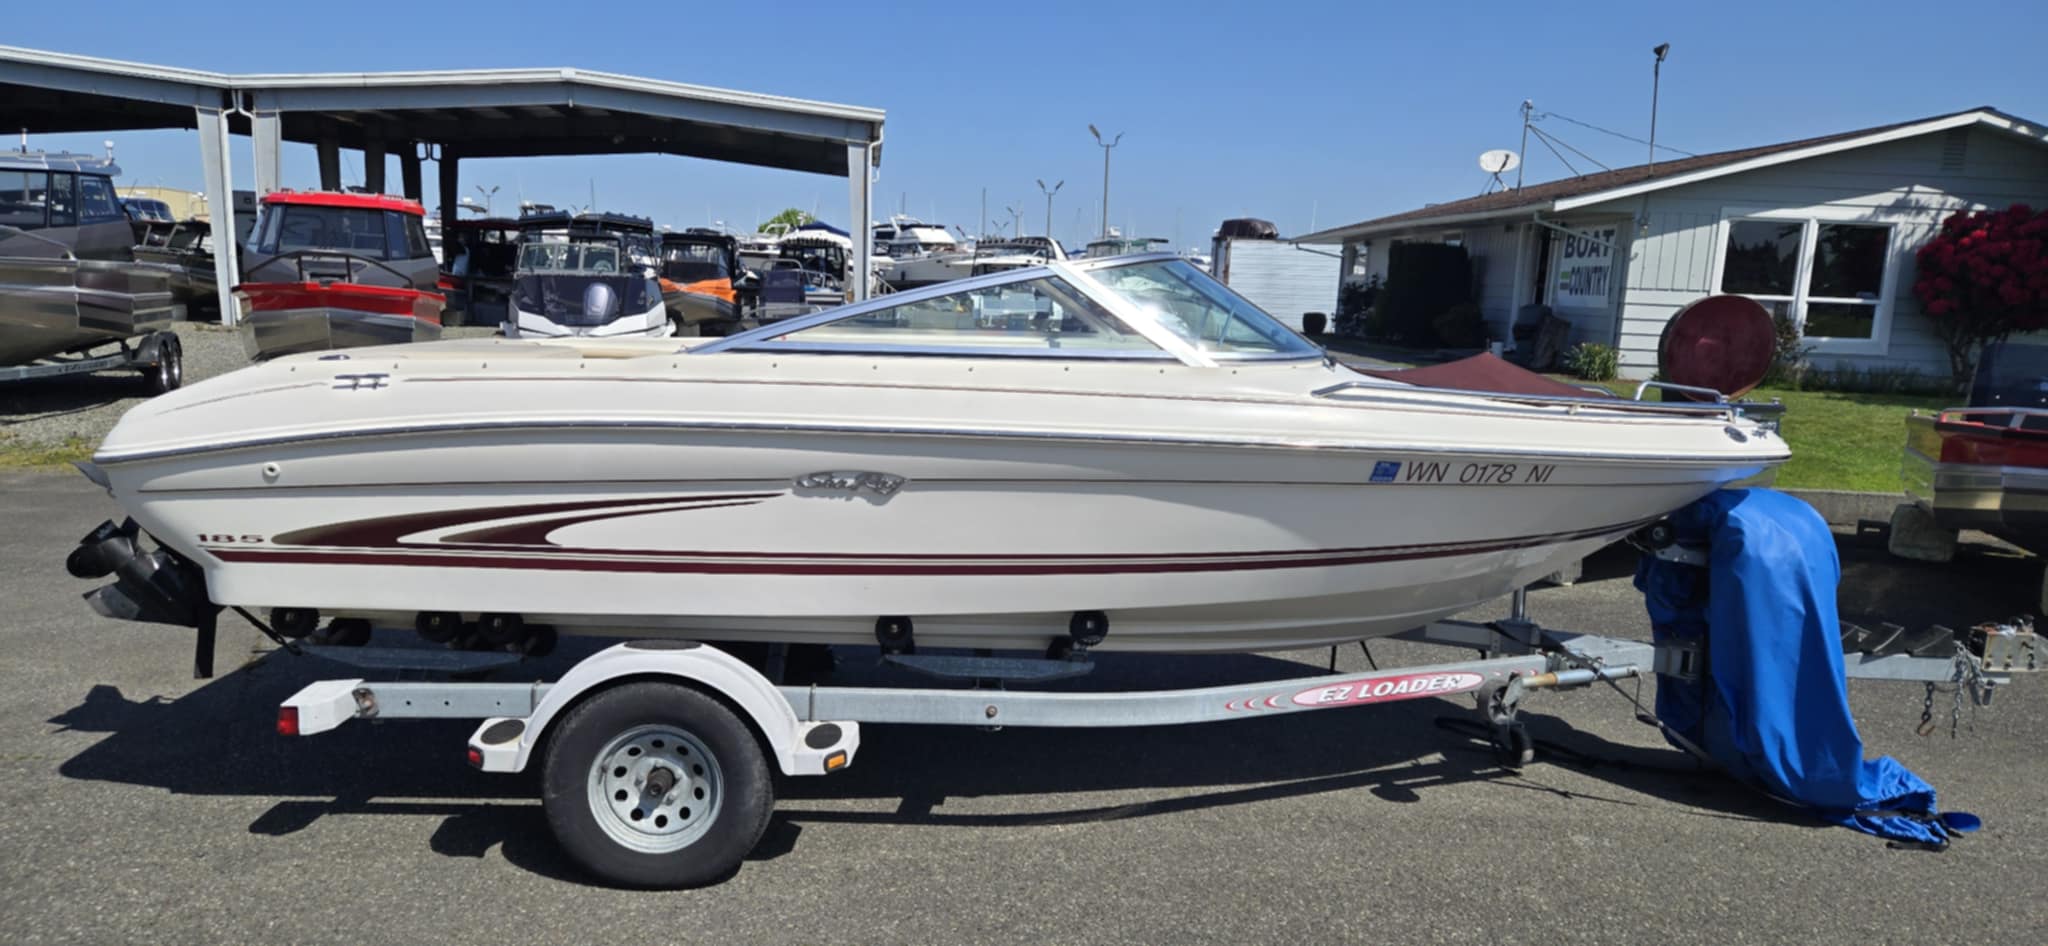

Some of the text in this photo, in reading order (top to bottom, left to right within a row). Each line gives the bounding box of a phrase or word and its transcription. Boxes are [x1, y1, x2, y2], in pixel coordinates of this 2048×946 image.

[1564, 229, 1615, 258] BOAT
[1569, 265, 1610, 297] COUNTRY
[1406, 461, 1450, 482] WN
[1459, 463, 1517, 483] 0178
[1524, 464, 1557, 483] NI
[197, 533, 265, 544] 185
[1316, 674, 1463, 704] EZ LOADER
